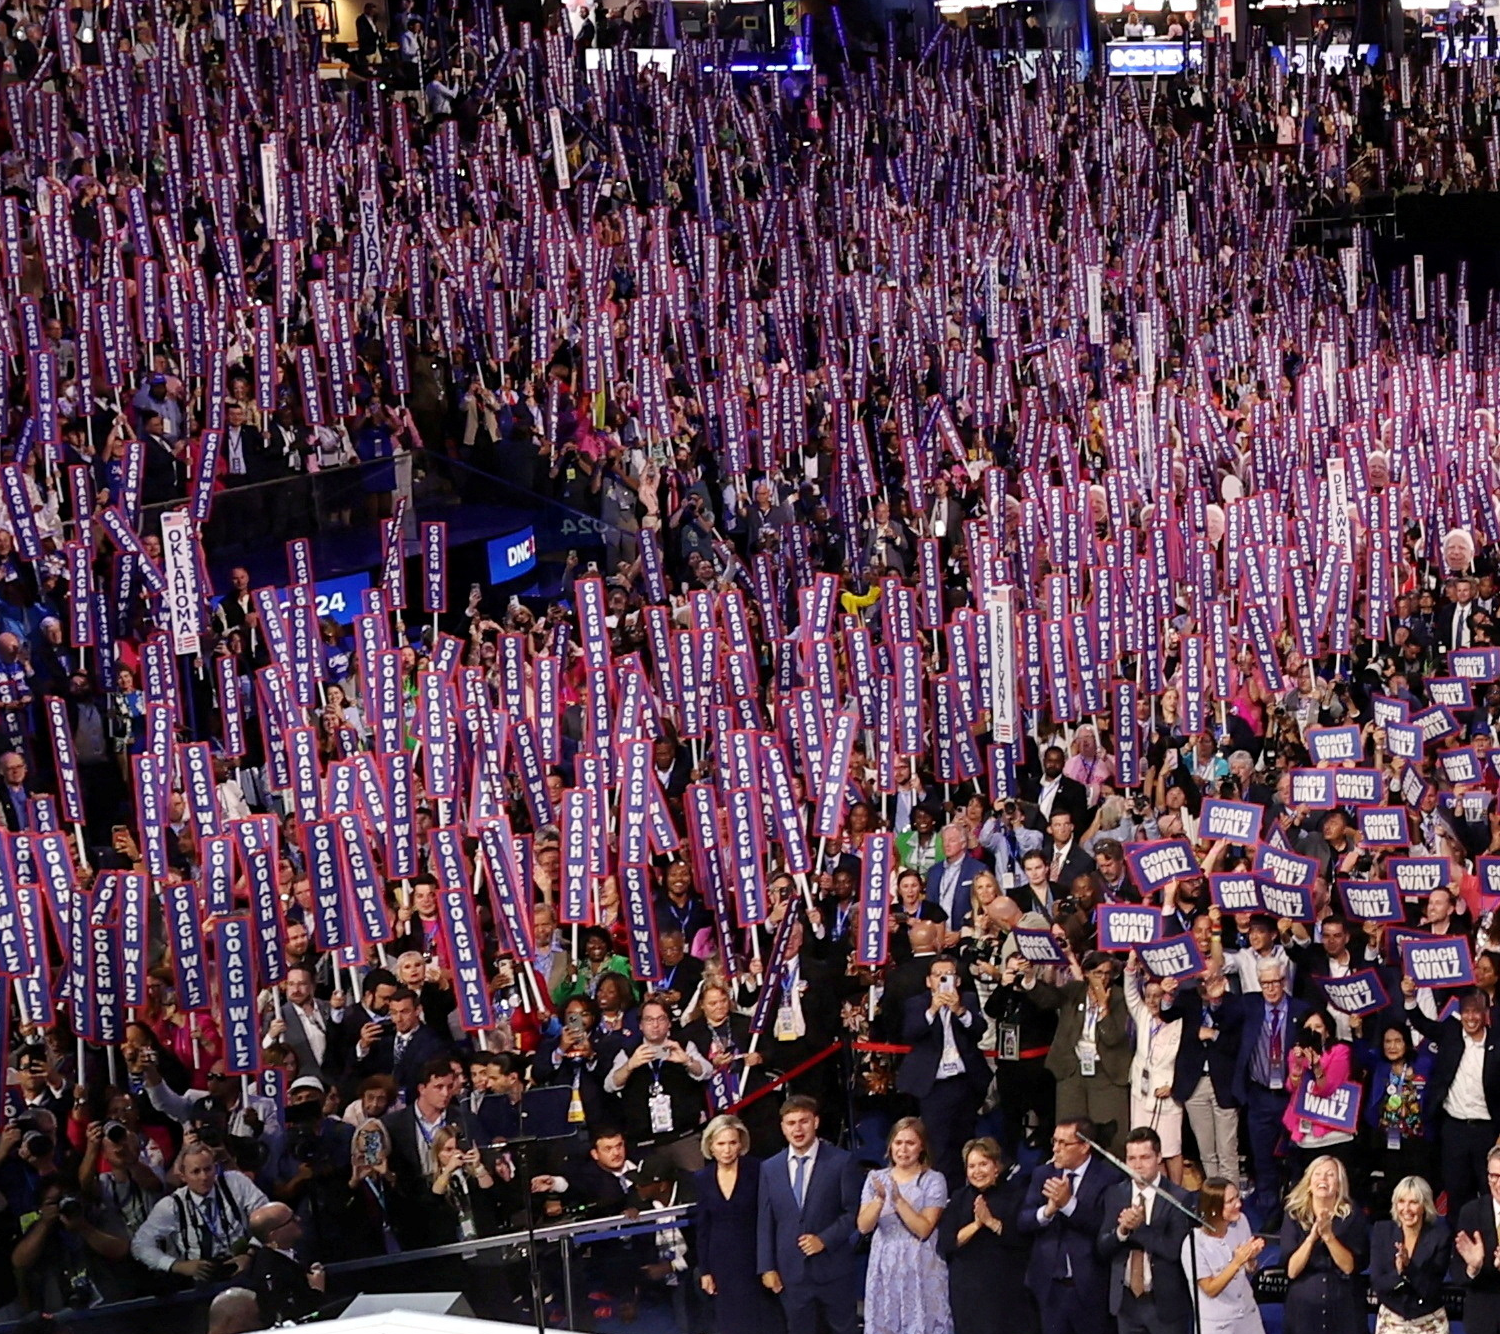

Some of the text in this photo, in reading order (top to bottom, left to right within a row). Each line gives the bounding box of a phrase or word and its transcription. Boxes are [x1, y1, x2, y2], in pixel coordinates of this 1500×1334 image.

[362, 201, 379, 273] NEVADA
[169, 530, 192, 634] OKLAHOMA
[996, 606, 1006, 719] PENNSYLVANIA
[1209, 818, 1252, 838] WALZ
[1210, 806, 1254, 824] COACH
[1411, 946, 1458, 964] COACH
[1411, 960, 1463, 980] WALZ
[225, 922, 249, 1066] COACH WALZ
